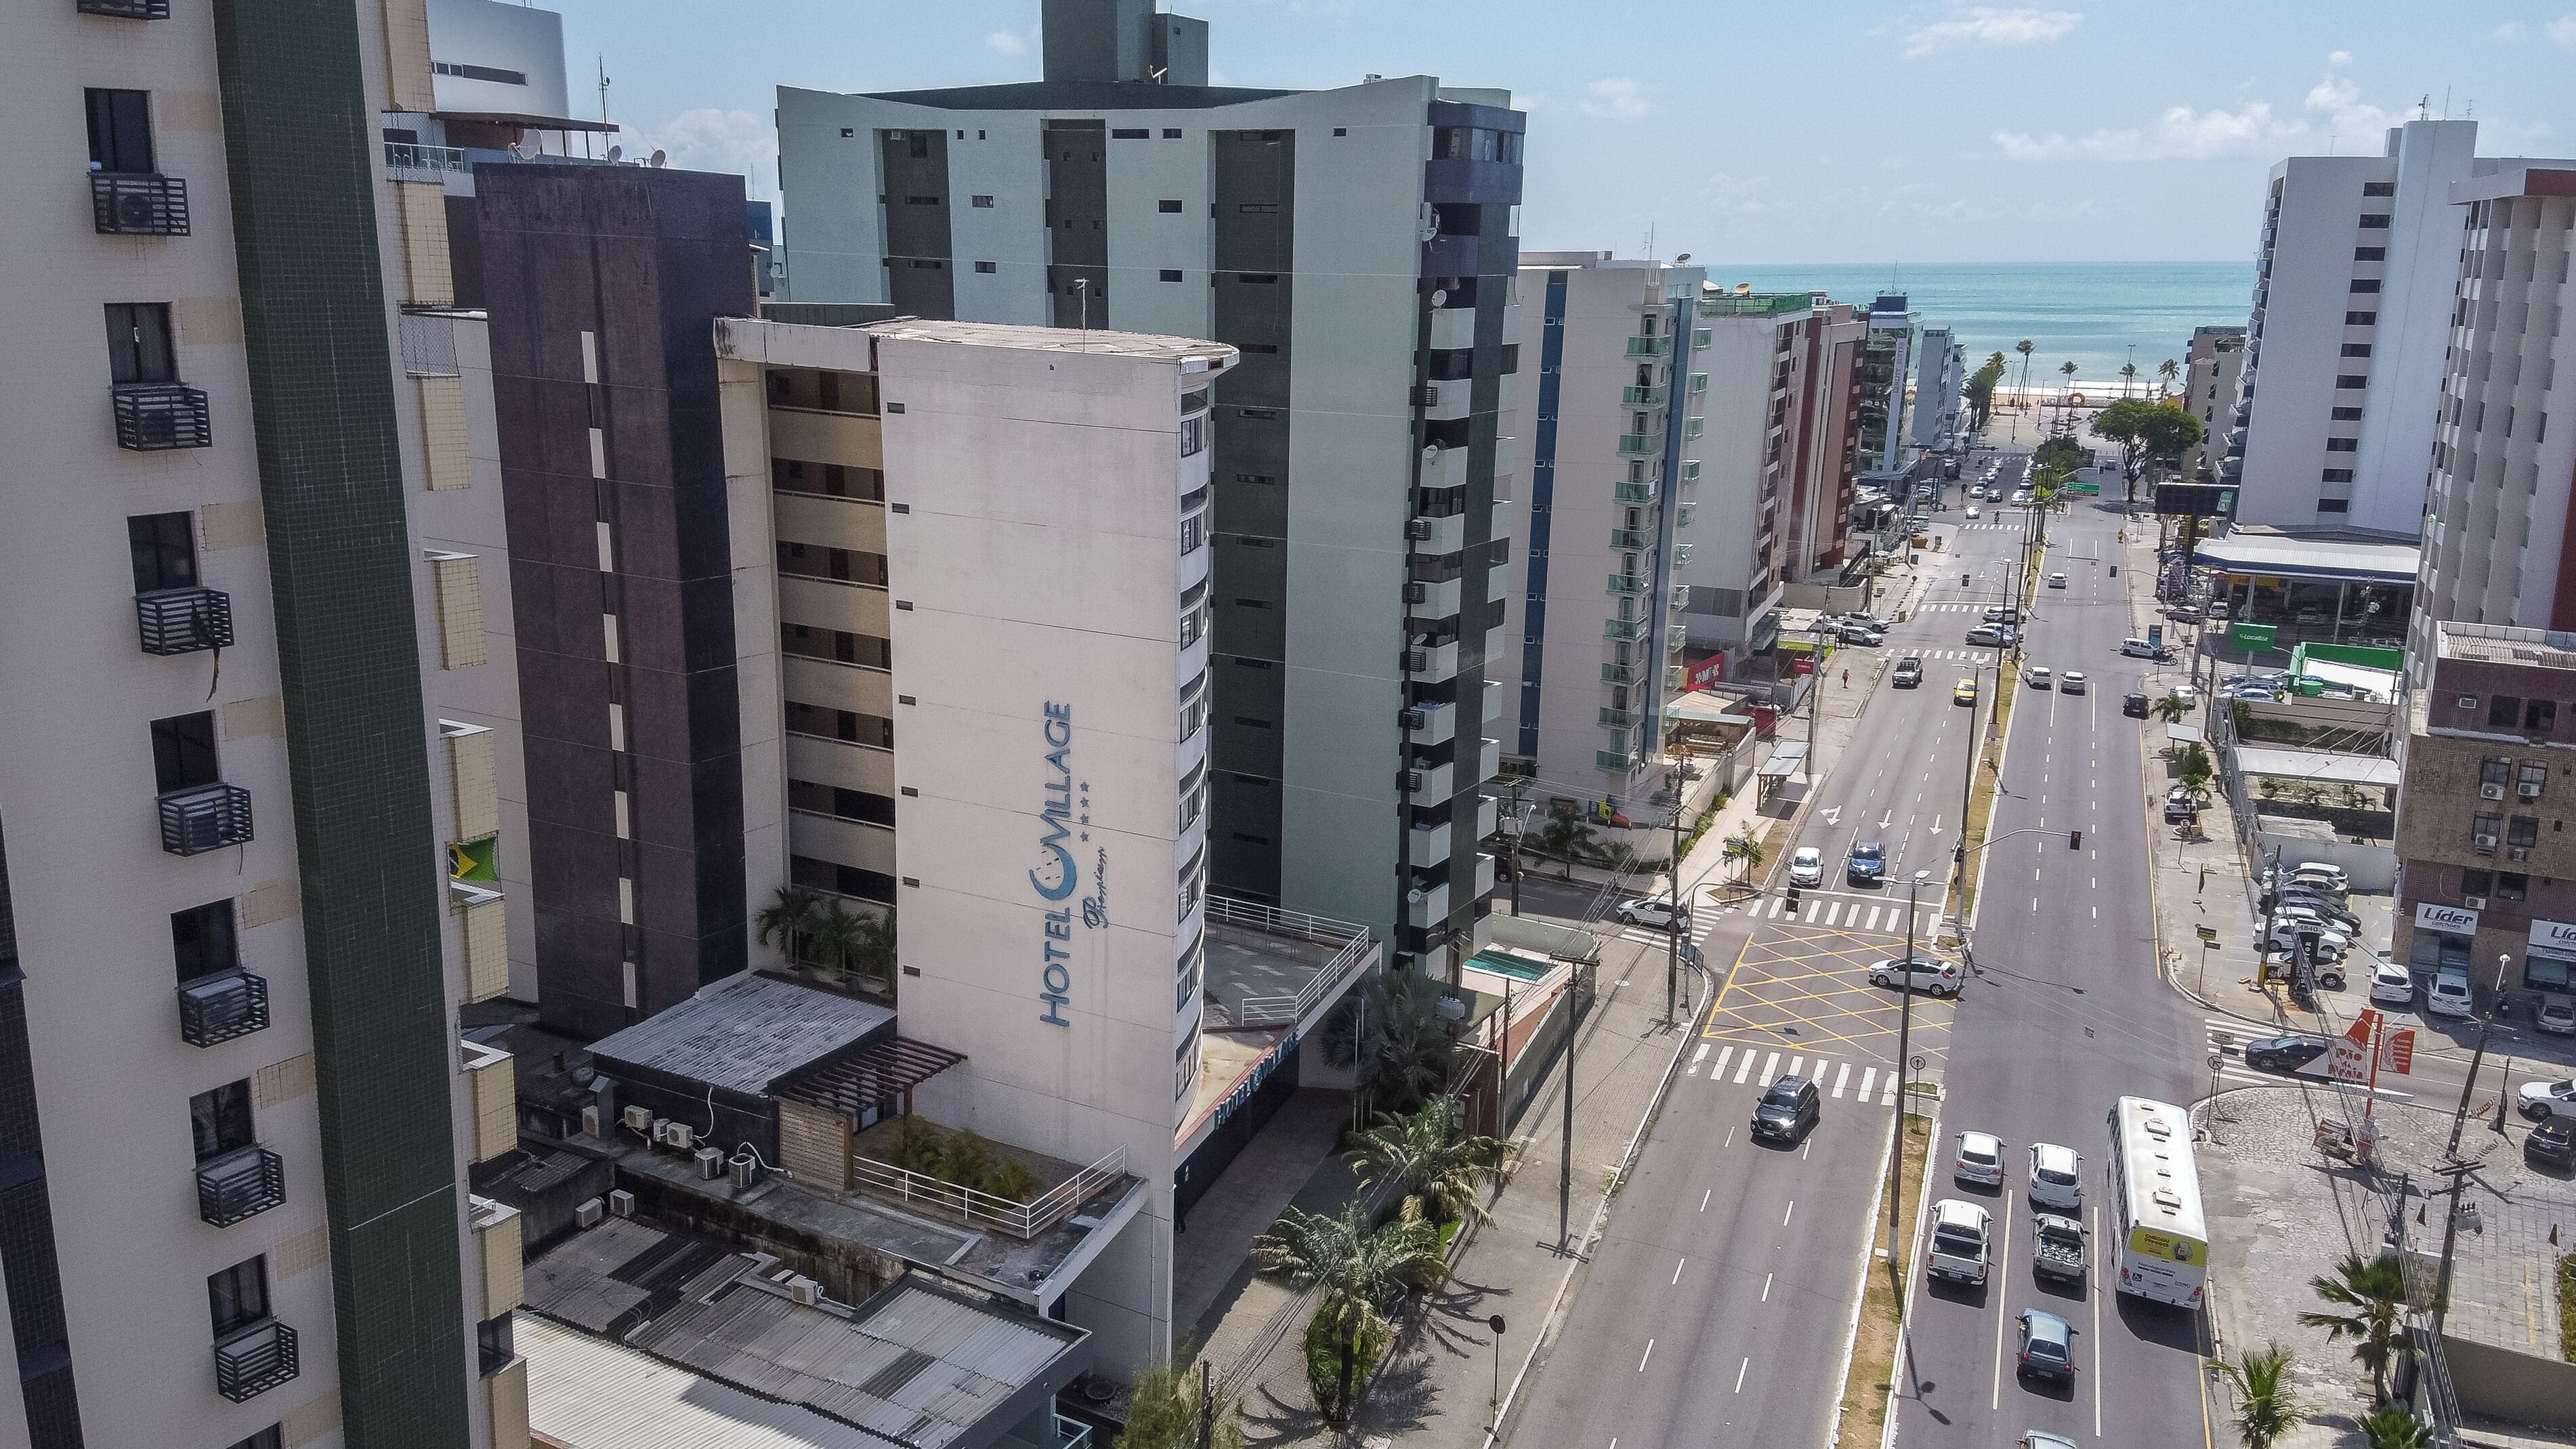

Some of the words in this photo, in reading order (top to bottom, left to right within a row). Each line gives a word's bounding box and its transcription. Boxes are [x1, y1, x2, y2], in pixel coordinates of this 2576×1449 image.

[1040, 700, 1070, 844] VILLAGE
[1082, 846, 1109, 929] Premium
[1040, 907, 1070, 1027] HOTEL
